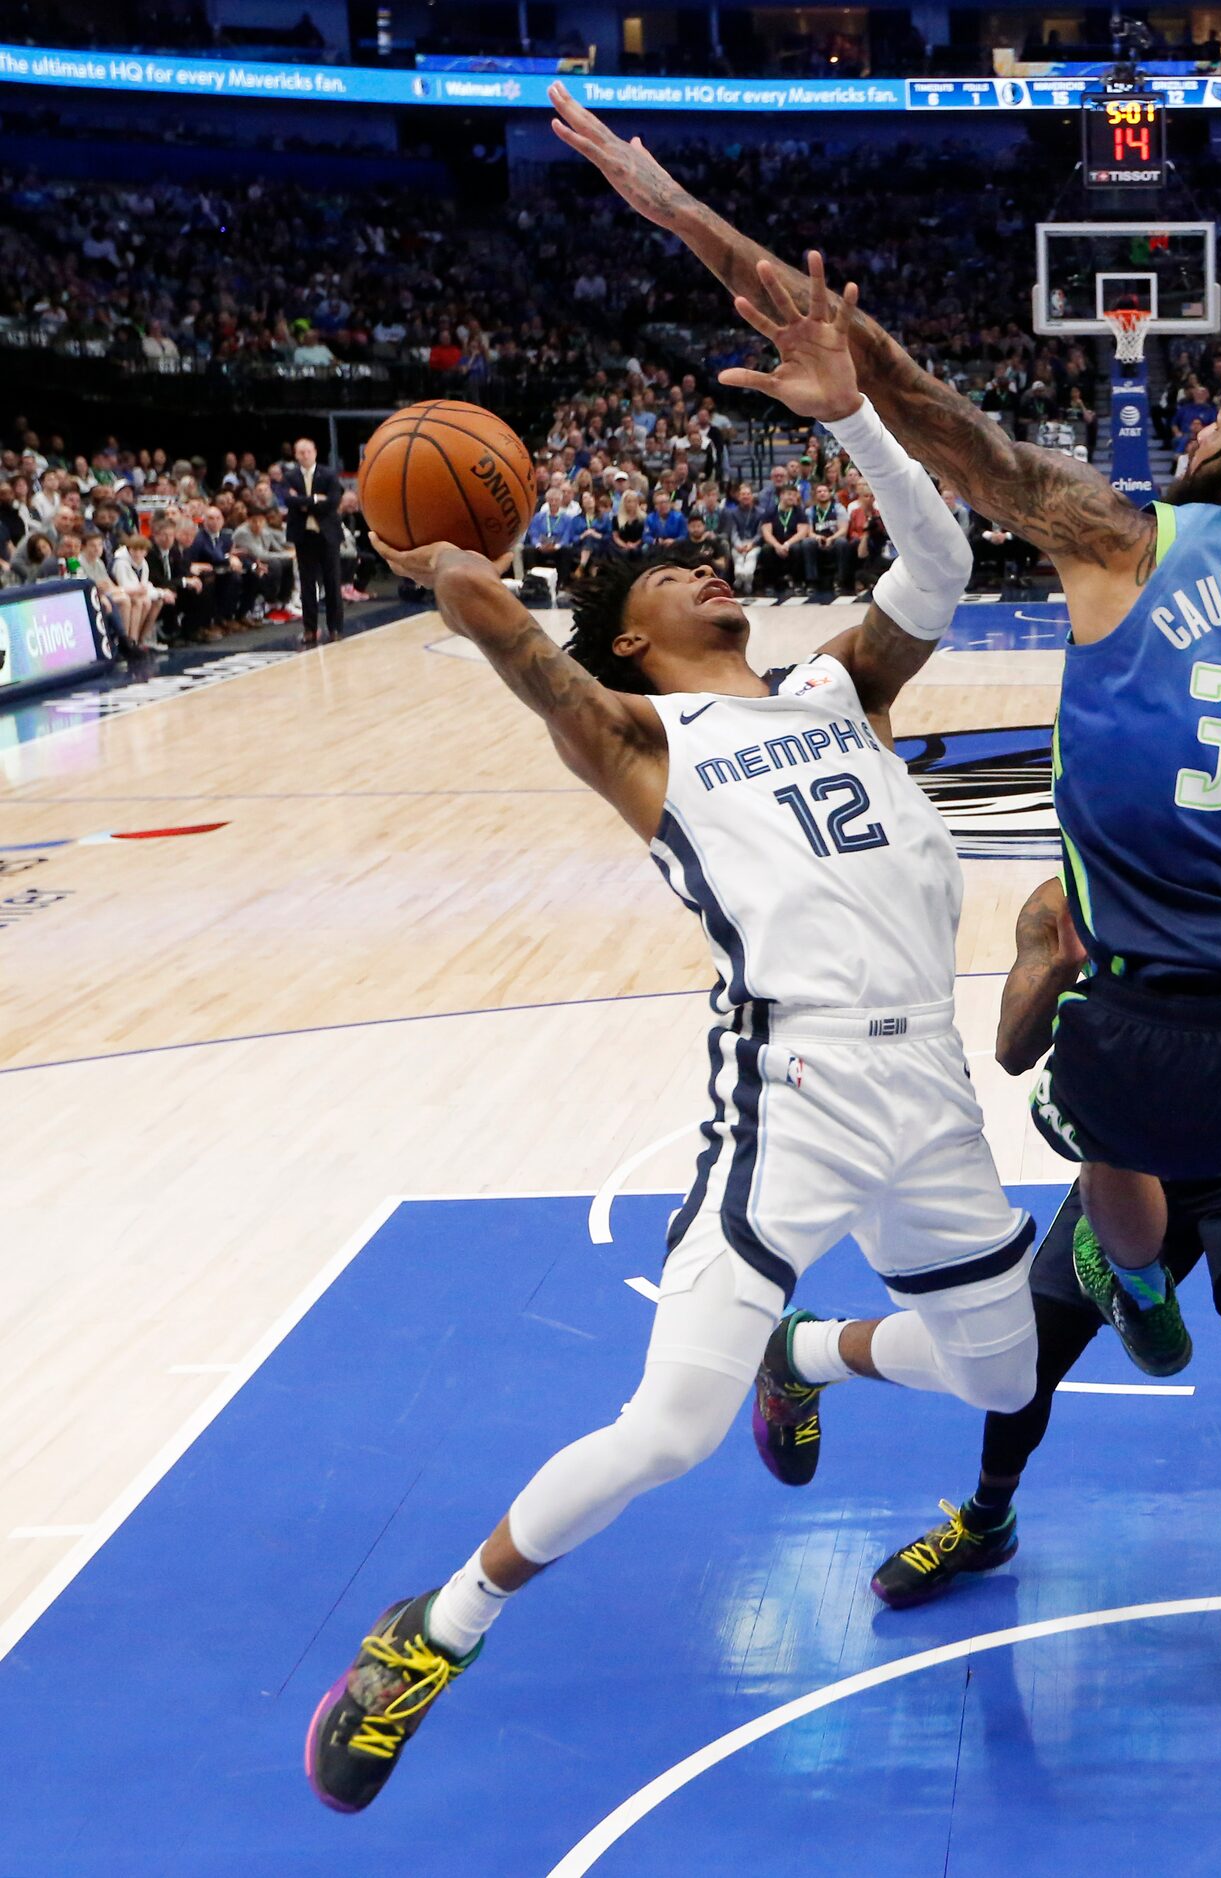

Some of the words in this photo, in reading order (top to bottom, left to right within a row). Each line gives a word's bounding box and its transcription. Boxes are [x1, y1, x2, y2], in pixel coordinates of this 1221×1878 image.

[0, 53, 29, 73] The
[32, 57, 106, 79] ultimate
[110, 61, 142, 83] HQ
[146, 63, 174, 83] for
[176, 69, 224, 90] every
[229, 69, 314, 91] Mavericks
[315, 72, 347, 93] fan.
[445, 80, 501, 97] Walmart
[583, 83, 614, 102] The
[617, 84, 682, 102] ultimate
[685, 85, 714, 104] HQ
[716, 85, 741, 103] for
[743, 89, 787, 108] every
[789, 86, 866, 104] Mavericks
[867, 86, 898, 103] fan.
[927, 93, 940, 106] 6
[971, 92, 981, 106] 1
[1051, 91, 1069, 106] 15
[1168, 91, 1185, 104] 12
[1106, 101, 1155, 125] 5:01
[1113, 127, 1150, 161] 14
[1111, 170, 1161, 182] TISSOT
[1118, 427, 1143, 438] AT&T
[1111, 477, 1153, 492] chime
[26, 617, 76, 658] chime
[772, 772, 890, 858] 12
